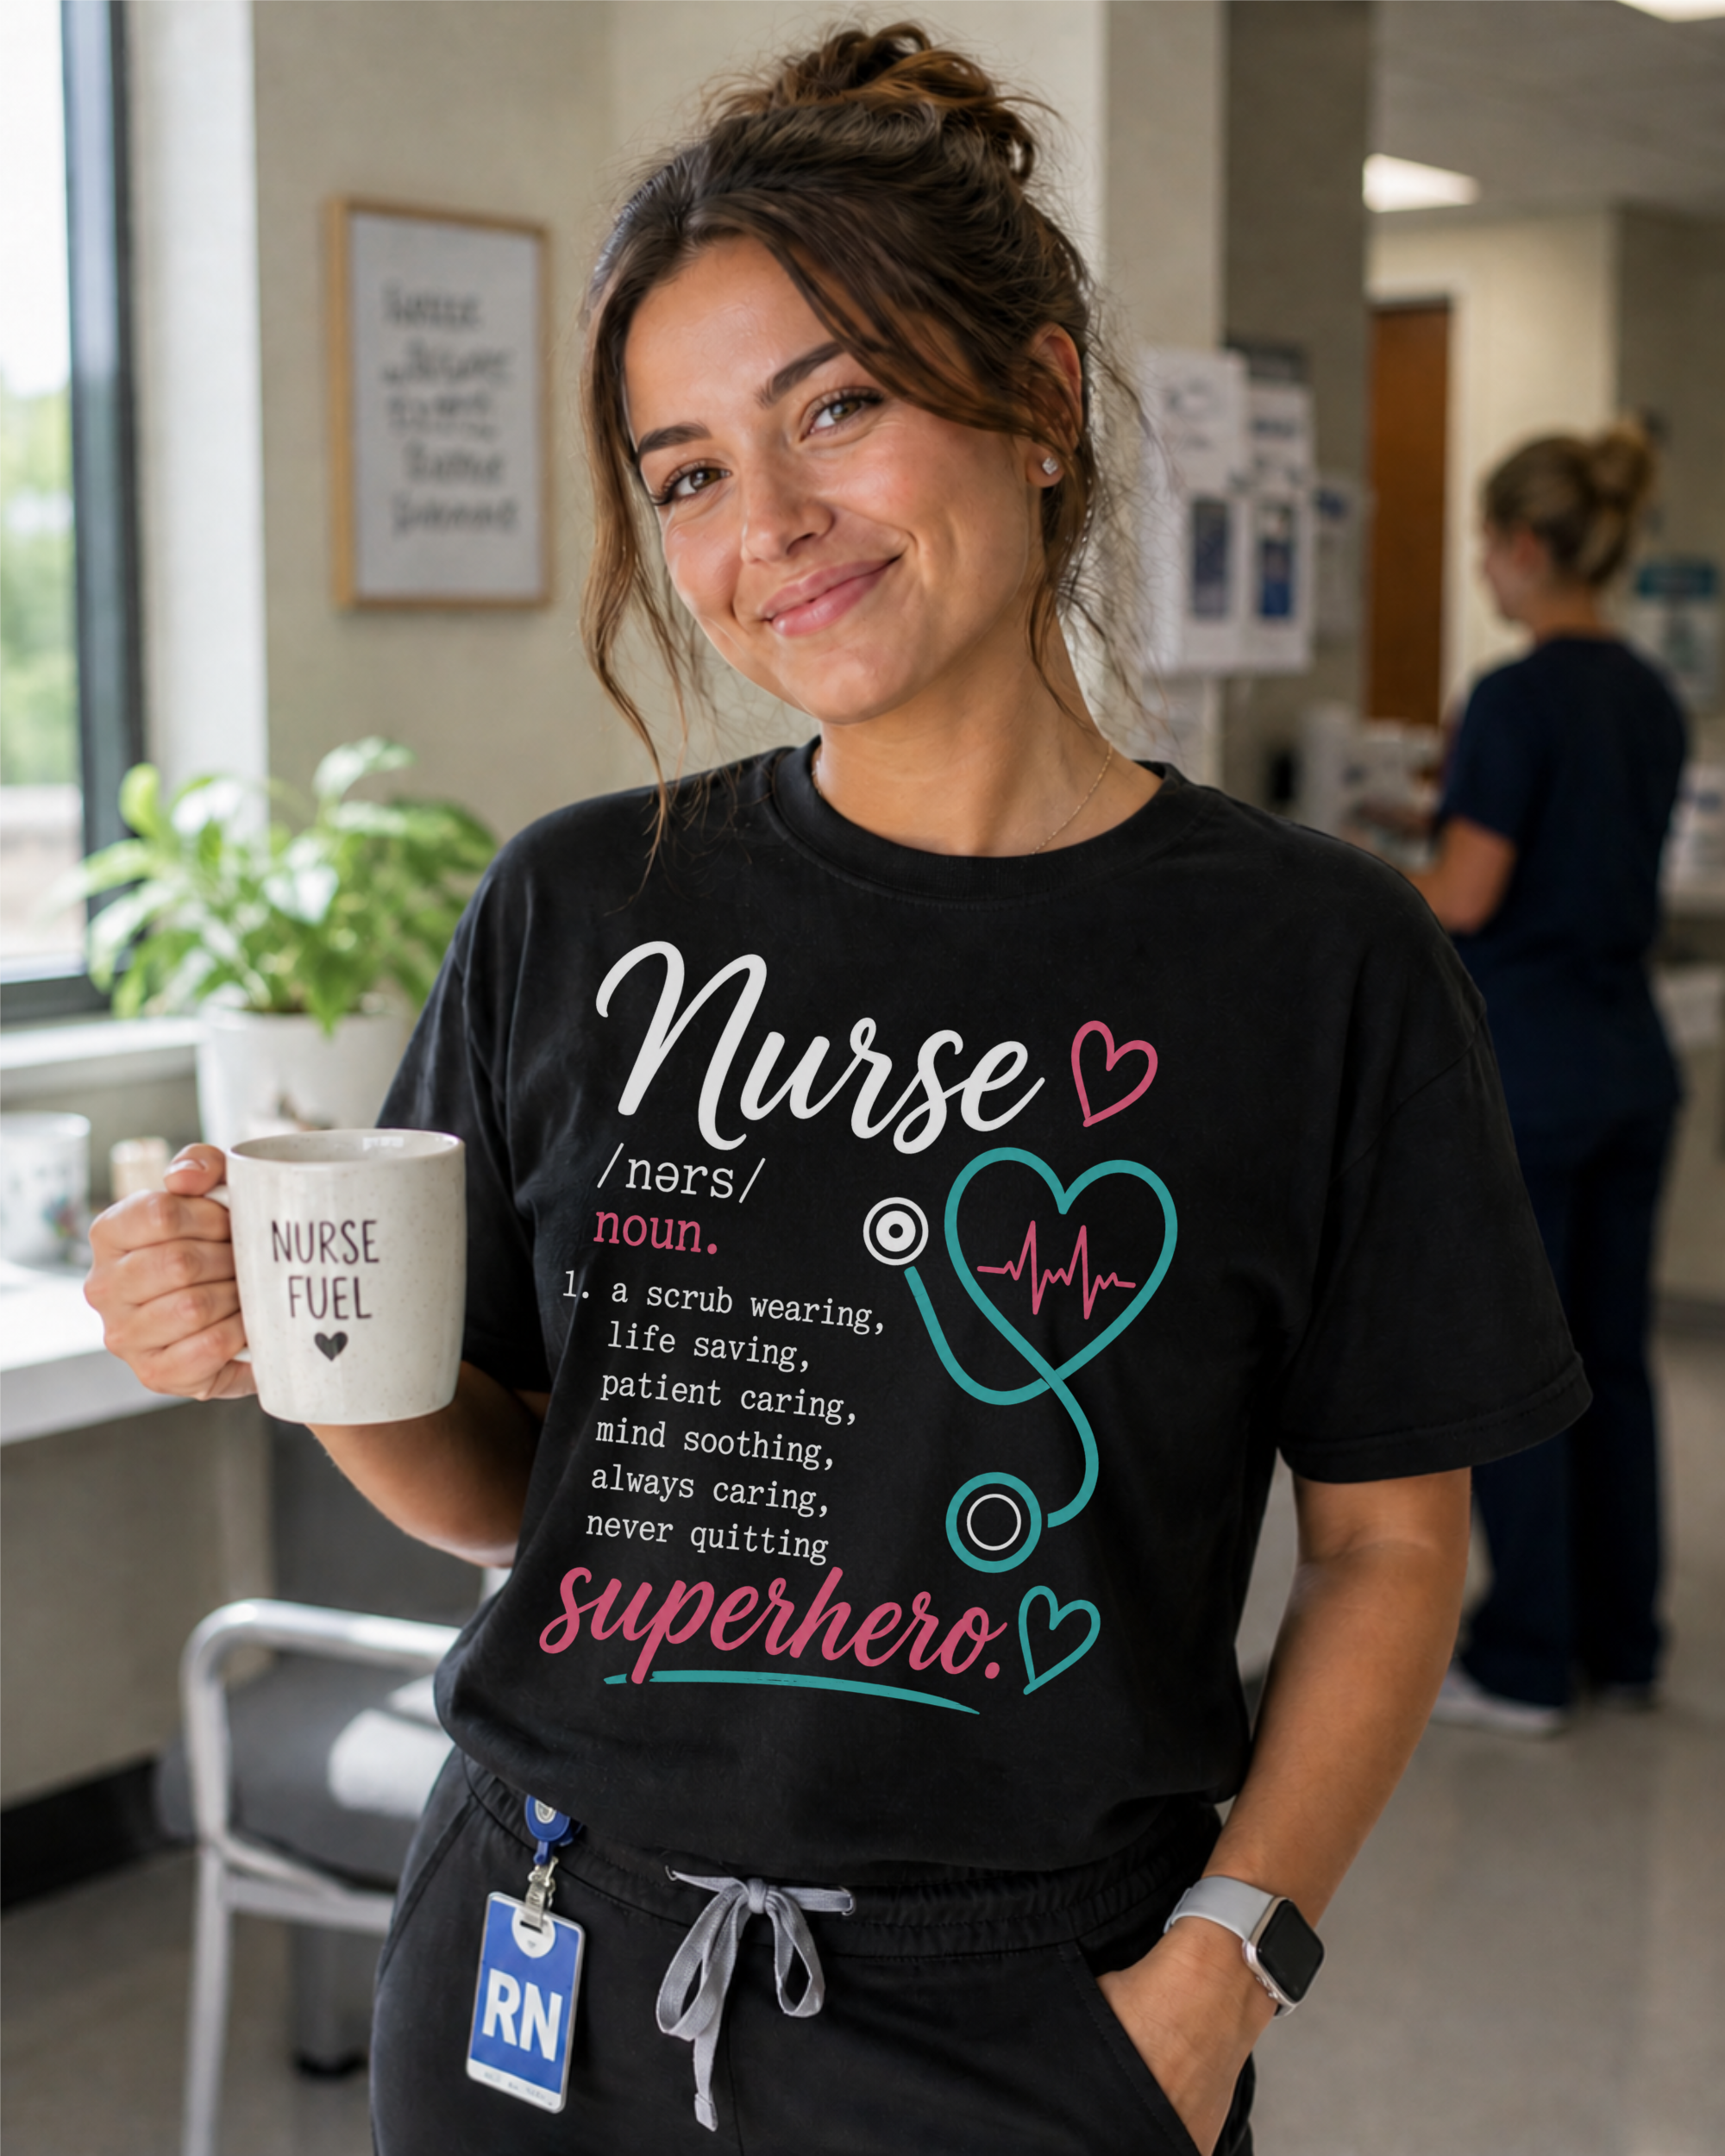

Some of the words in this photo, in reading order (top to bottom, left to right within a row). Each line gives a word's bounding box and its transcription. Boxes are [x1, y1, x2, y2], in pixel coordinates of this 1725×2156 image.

[595, 940, 1045, 1155] Nurse
[271, 1219, 380, 1265] NURSE
[593, 1210, 718, 1255] noun.
[288, 1275, 373, 1320] FUEL
[562, 1269, 589, 1299] 1.
[612, 1282, 629, 1303] a
[646, 1286, 733, 1314] scrub
[750, 1296, 883, 1336] wearing,
[607, 1320, 675, 1353] life
[693, 1335, 809, 1373] saving,
[599, 1372, 722, 1407] patient
[740, 1388, 856, 1426] caring,
[595, 1417, 666, 1448] mind
[683, 1430, 833, 1471] soothing,
[591, 1463, 694, 1503] always
[712, 1480, 828, 1518] caring,
[586, 1514, 674, 1543] never
[690, 1523, 829, 1566] quitting
[538, 1566, 1008, 1685] superhero.
[482, 1967, 562, 2062] RN
